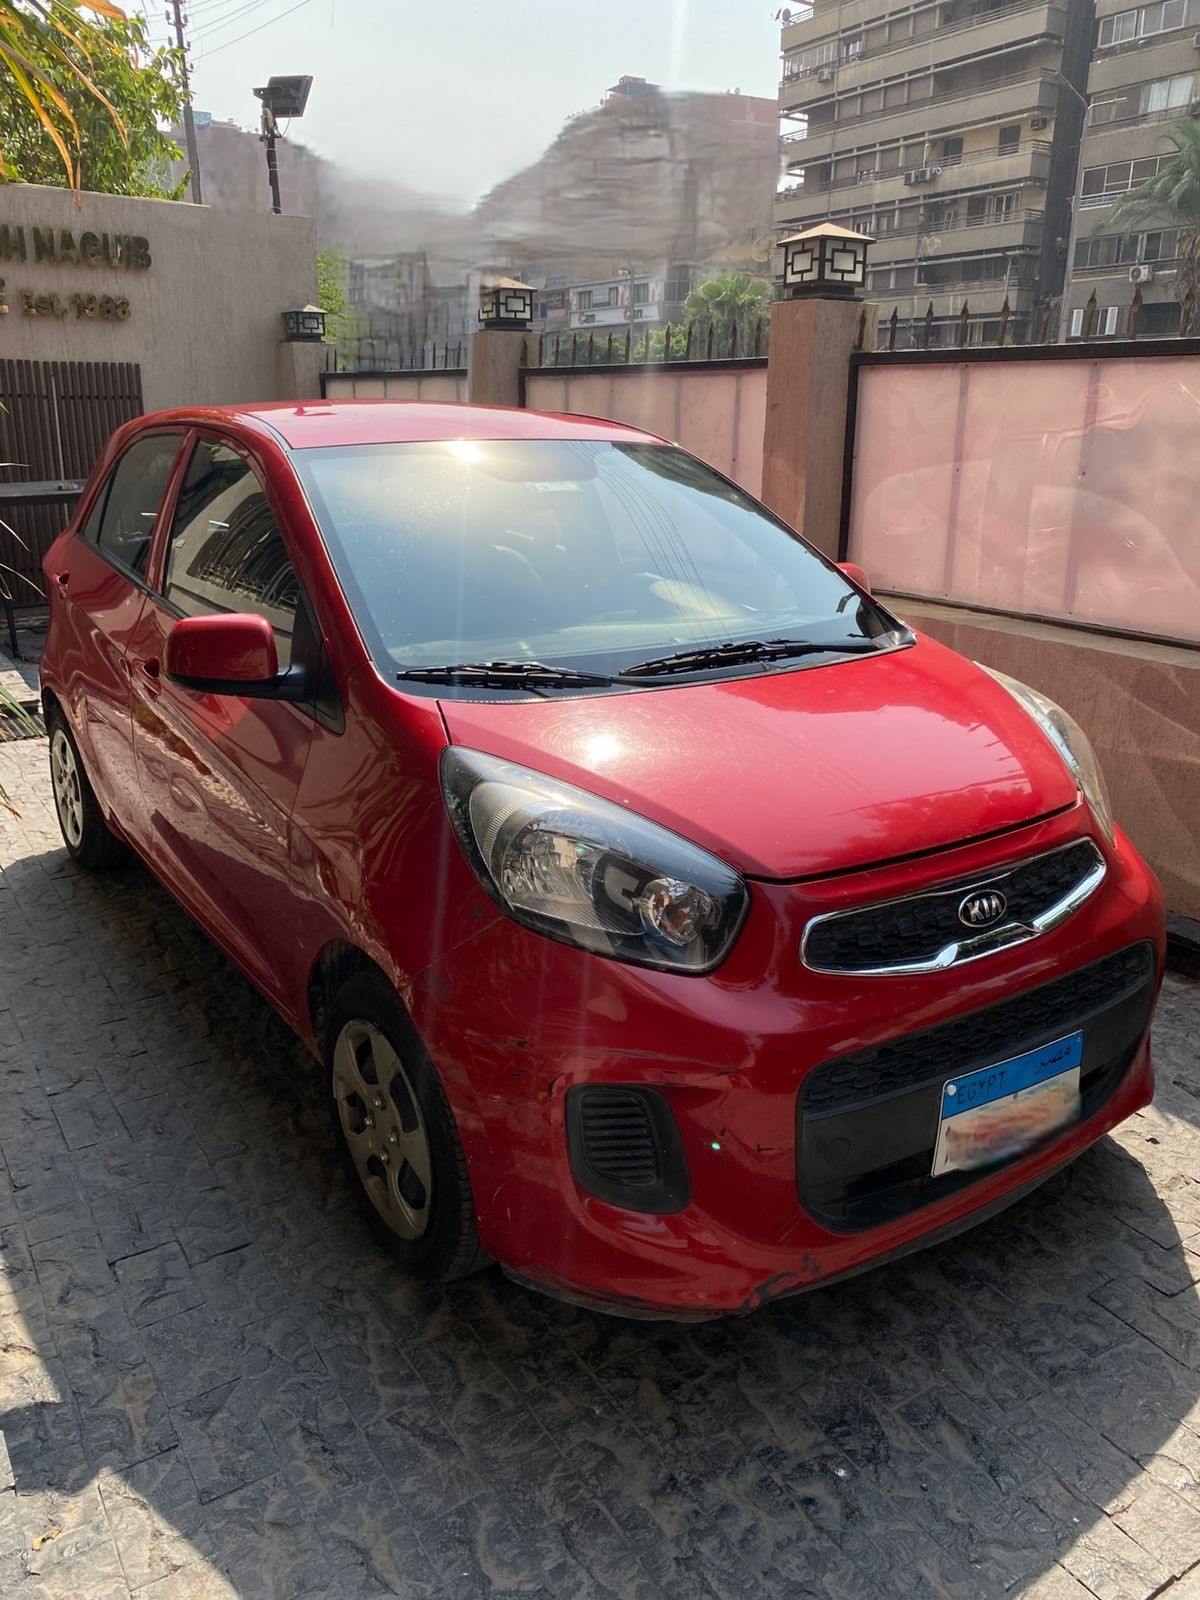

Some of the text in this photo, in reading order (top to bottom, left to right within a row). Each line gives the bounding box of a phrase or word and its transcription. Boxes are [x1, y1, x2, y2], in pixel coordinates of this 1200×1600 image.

[966, 895, 1003, 922] KIA
[1033, 1046, 1071, 1075] مصر
[957, 1071, 1007, 1104] EGYPT
